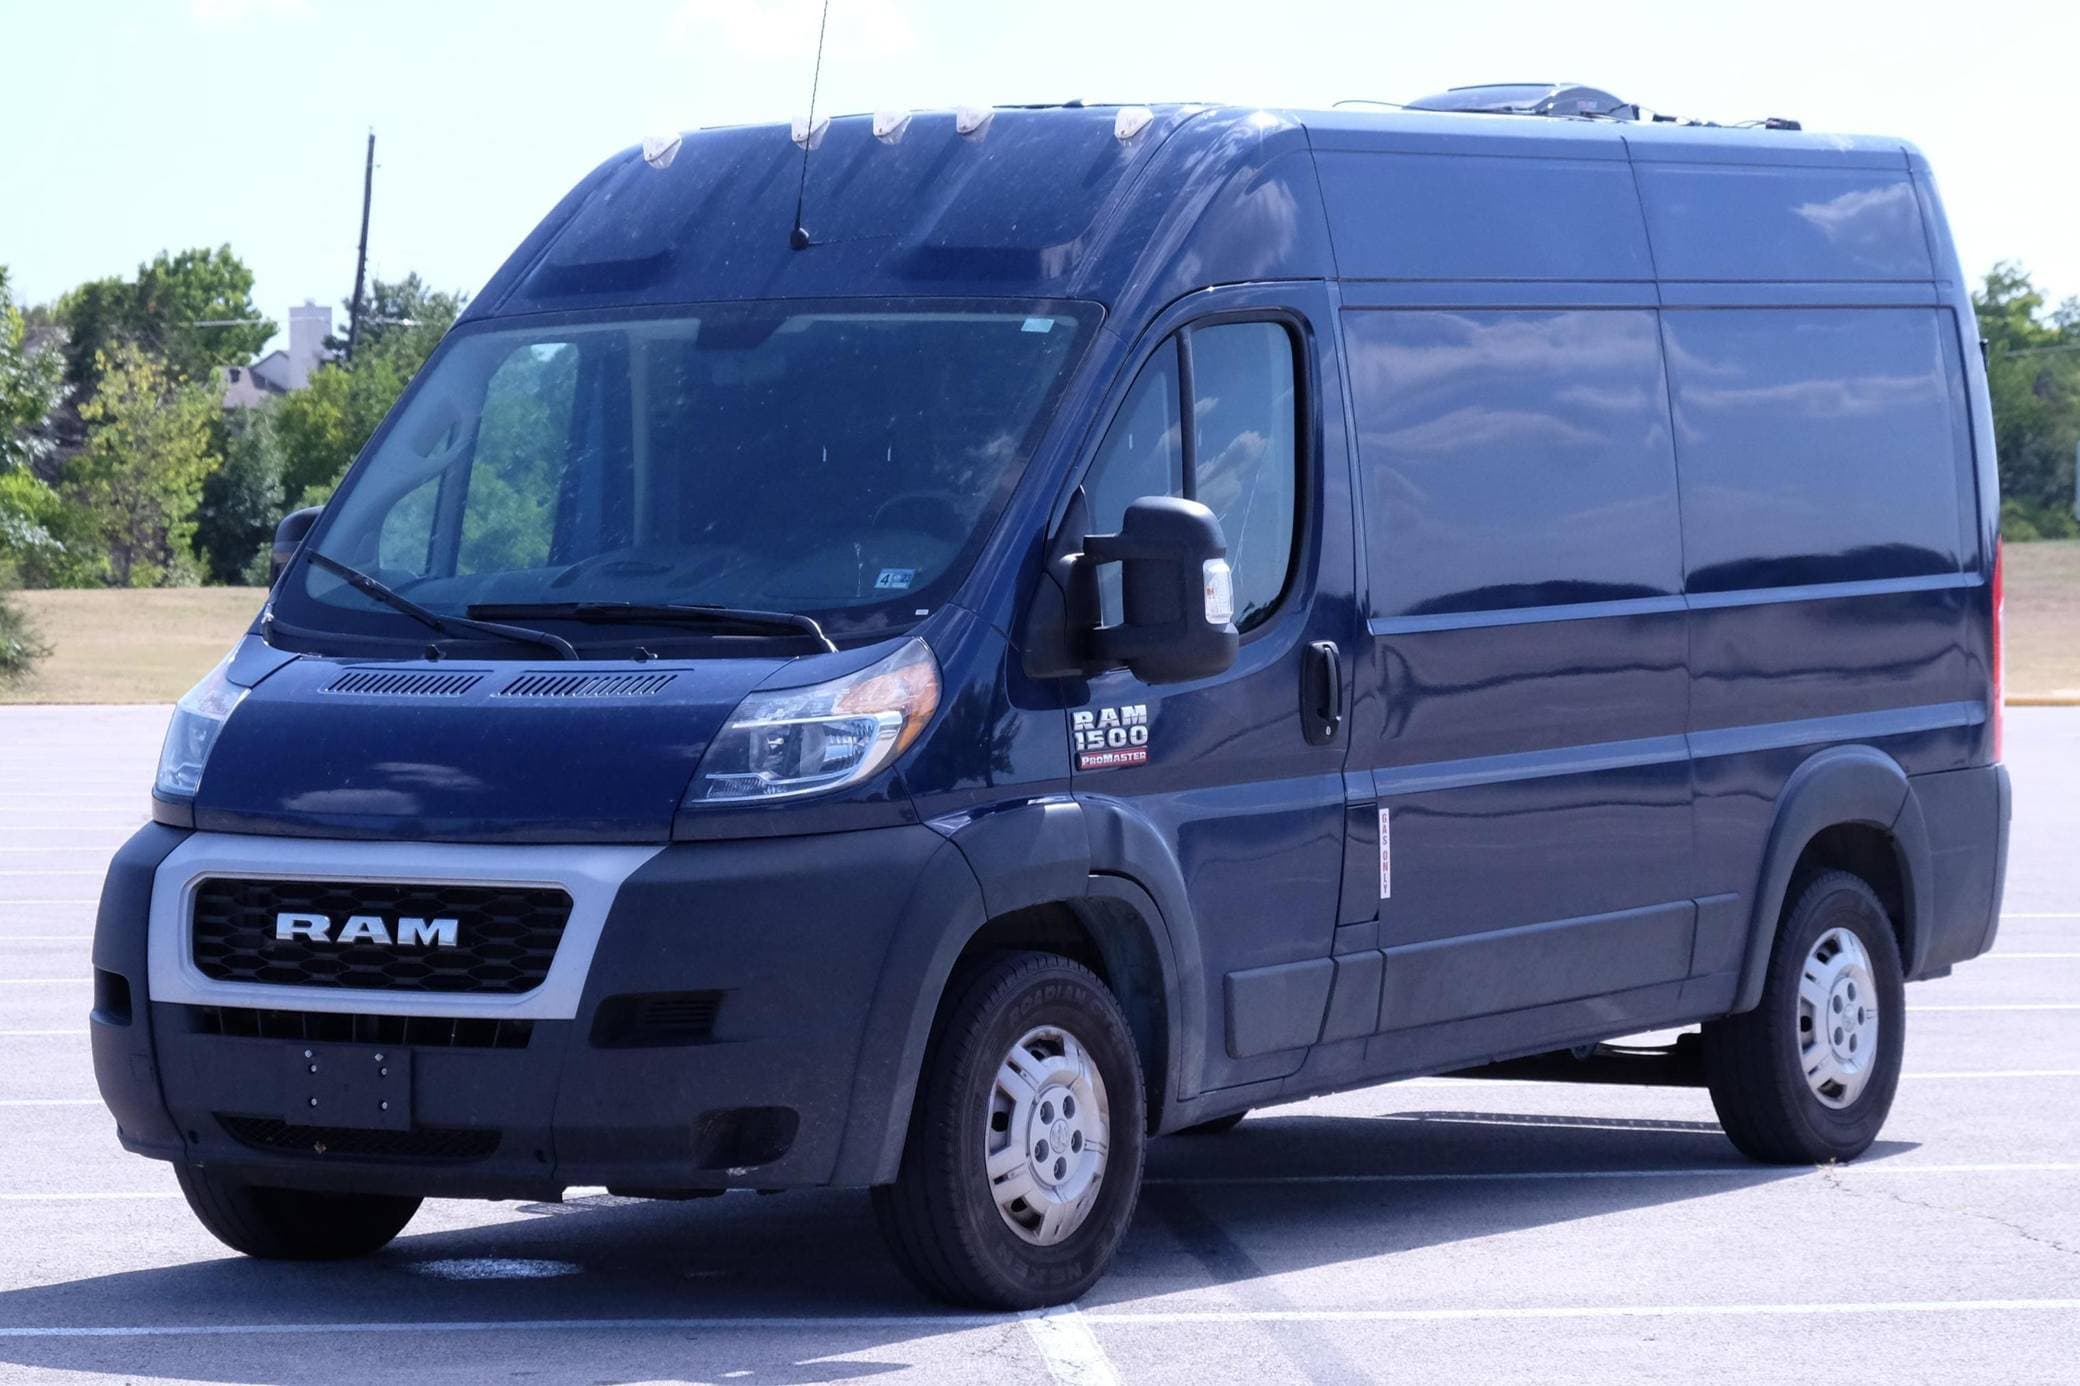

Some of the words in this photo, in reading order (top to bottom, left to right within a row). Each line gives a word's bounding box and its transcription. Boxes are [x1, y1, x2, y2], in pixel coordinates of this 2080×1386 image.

[880, 573, 890, 585] 4
[1073, 704, 1147, 731] RAM
[1074, 725, 1148, 751] 1500
[275, 912, 459, 947] RAM
